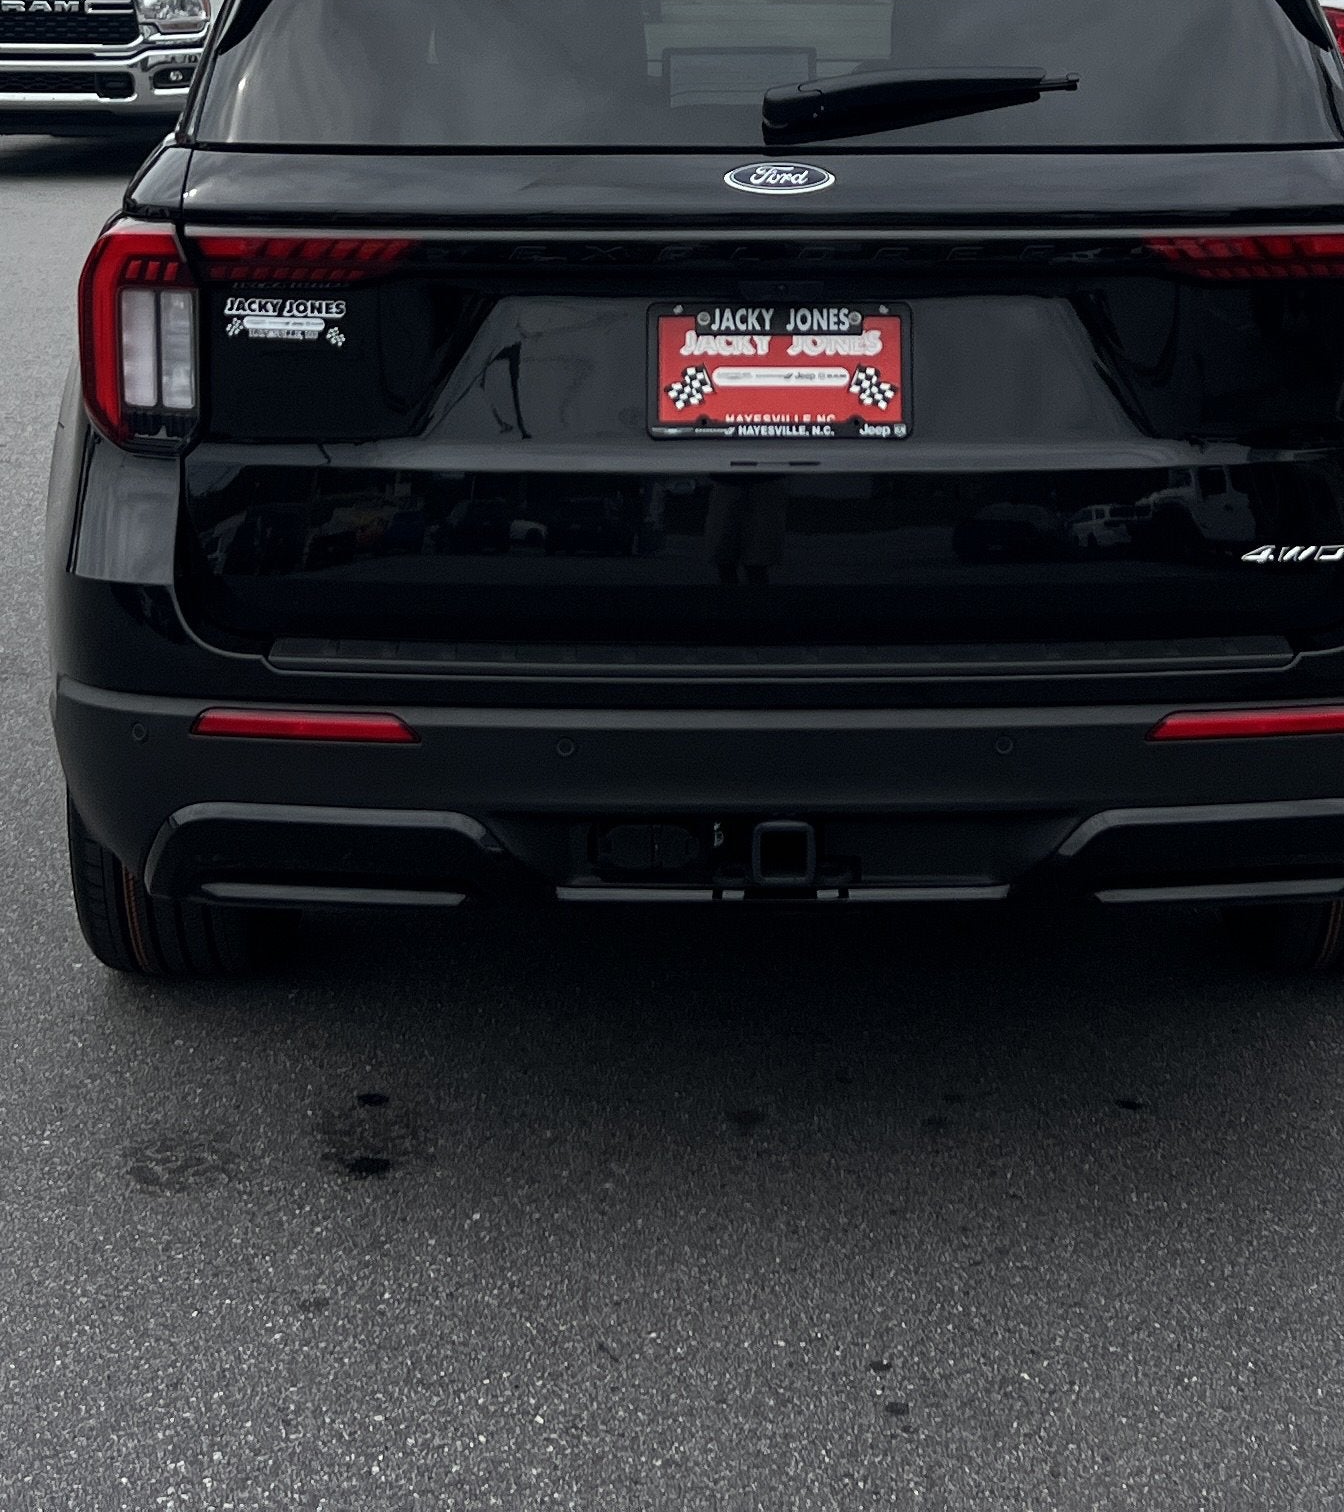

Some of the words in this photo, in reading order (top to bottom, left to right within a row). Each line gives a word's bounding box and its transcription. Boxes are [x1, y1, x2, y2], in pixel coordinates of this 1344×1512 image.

[1, 0, 80, 12] RAM
[750, 166, 809, 185] Ford
[224, 297, 282, 316] JACKY
[282, 299, 346, 318] JONES
[711, 308, 774, 331] JACKY
[786, 308, 850, 331] JONES
[812, 424, 835, 436] N.C.
[859, 424, 891, 437] Jeep
